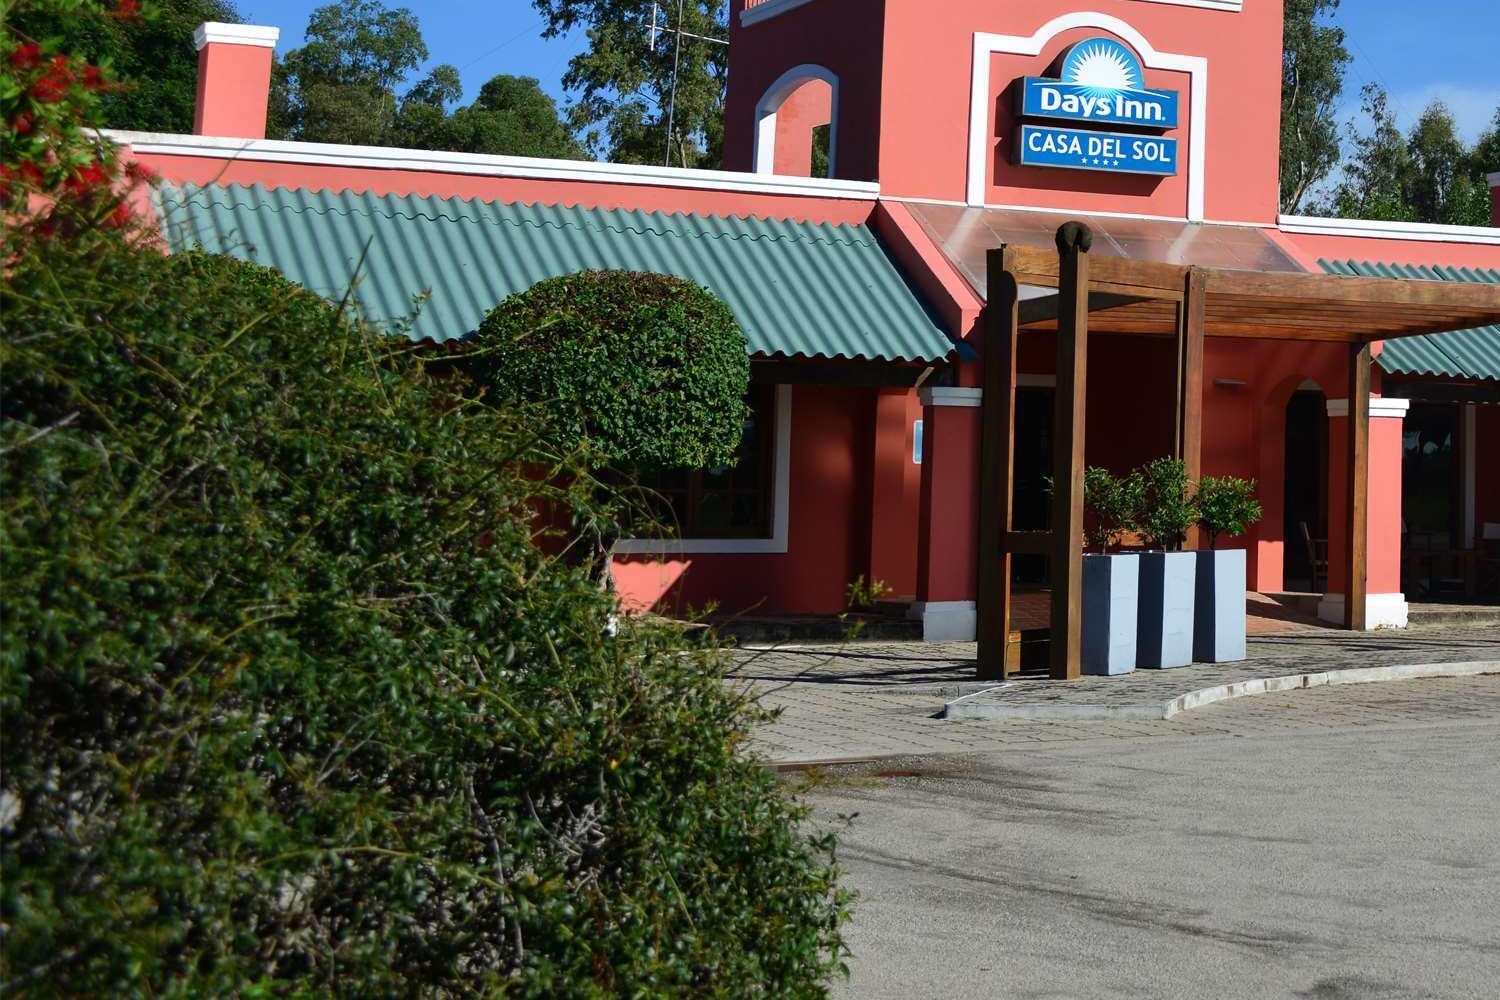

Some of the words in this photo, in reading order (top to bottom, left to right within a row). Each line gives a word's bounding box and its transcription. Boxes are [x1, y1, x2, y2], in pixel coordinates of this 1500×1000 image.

[1041, 87, 1112, 118] Days
[1028, 132, 1083, 155] CASA
[1088, 137, 1126, 159] DEL
[1132, 141, 1171, 162] SOL
